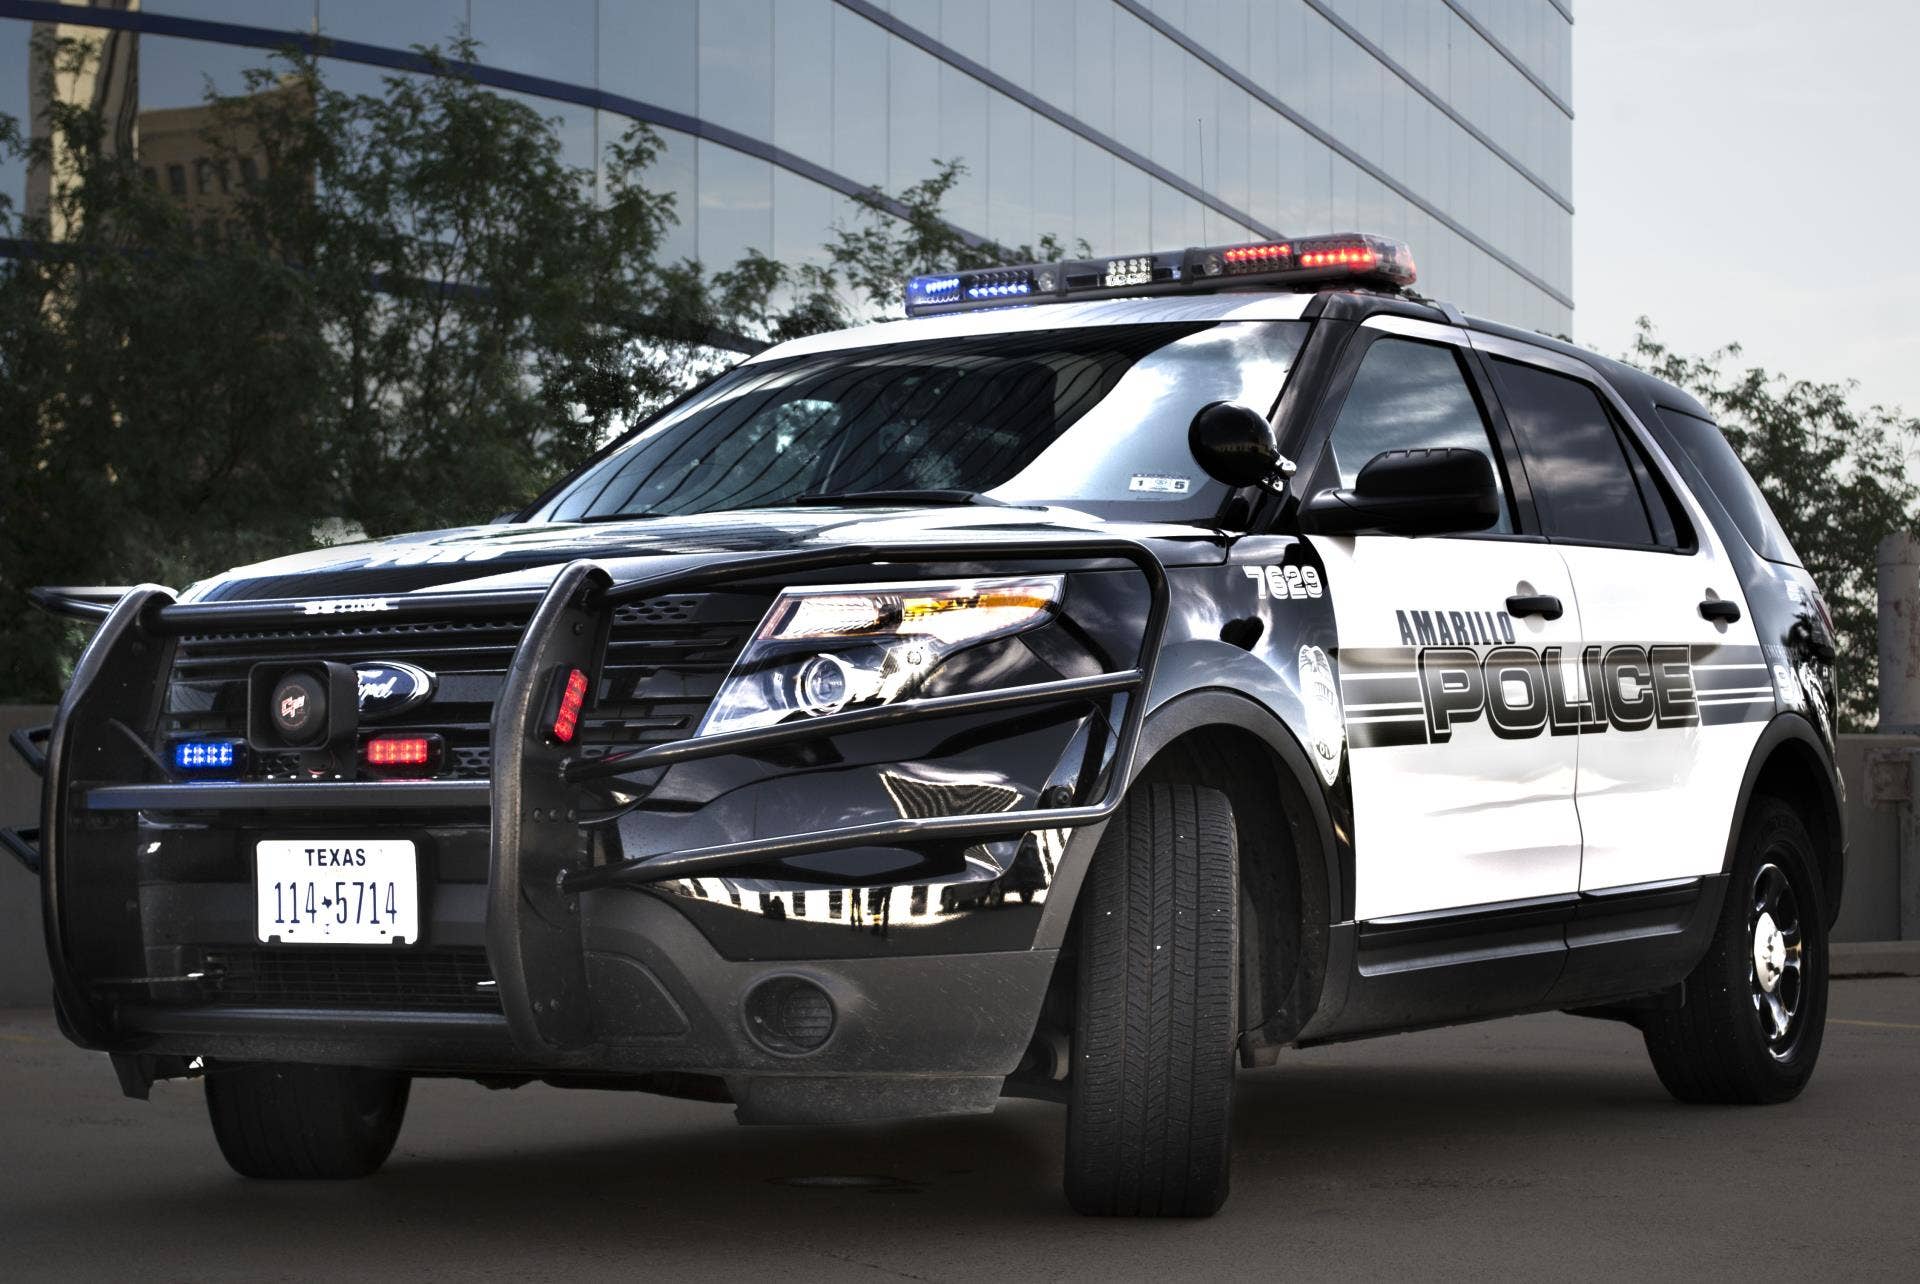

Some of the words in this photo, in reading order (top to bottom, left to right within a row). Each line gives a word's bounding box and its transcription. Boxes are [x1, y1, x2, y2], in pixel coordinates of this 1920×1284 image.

[1242, 564, 1323, 600] 7629
[1395, 609, 1516, 645] AMARILLO
[1417, 644, 1700, 744] POLICE
[304, 848, 366, 867] TEXAS
